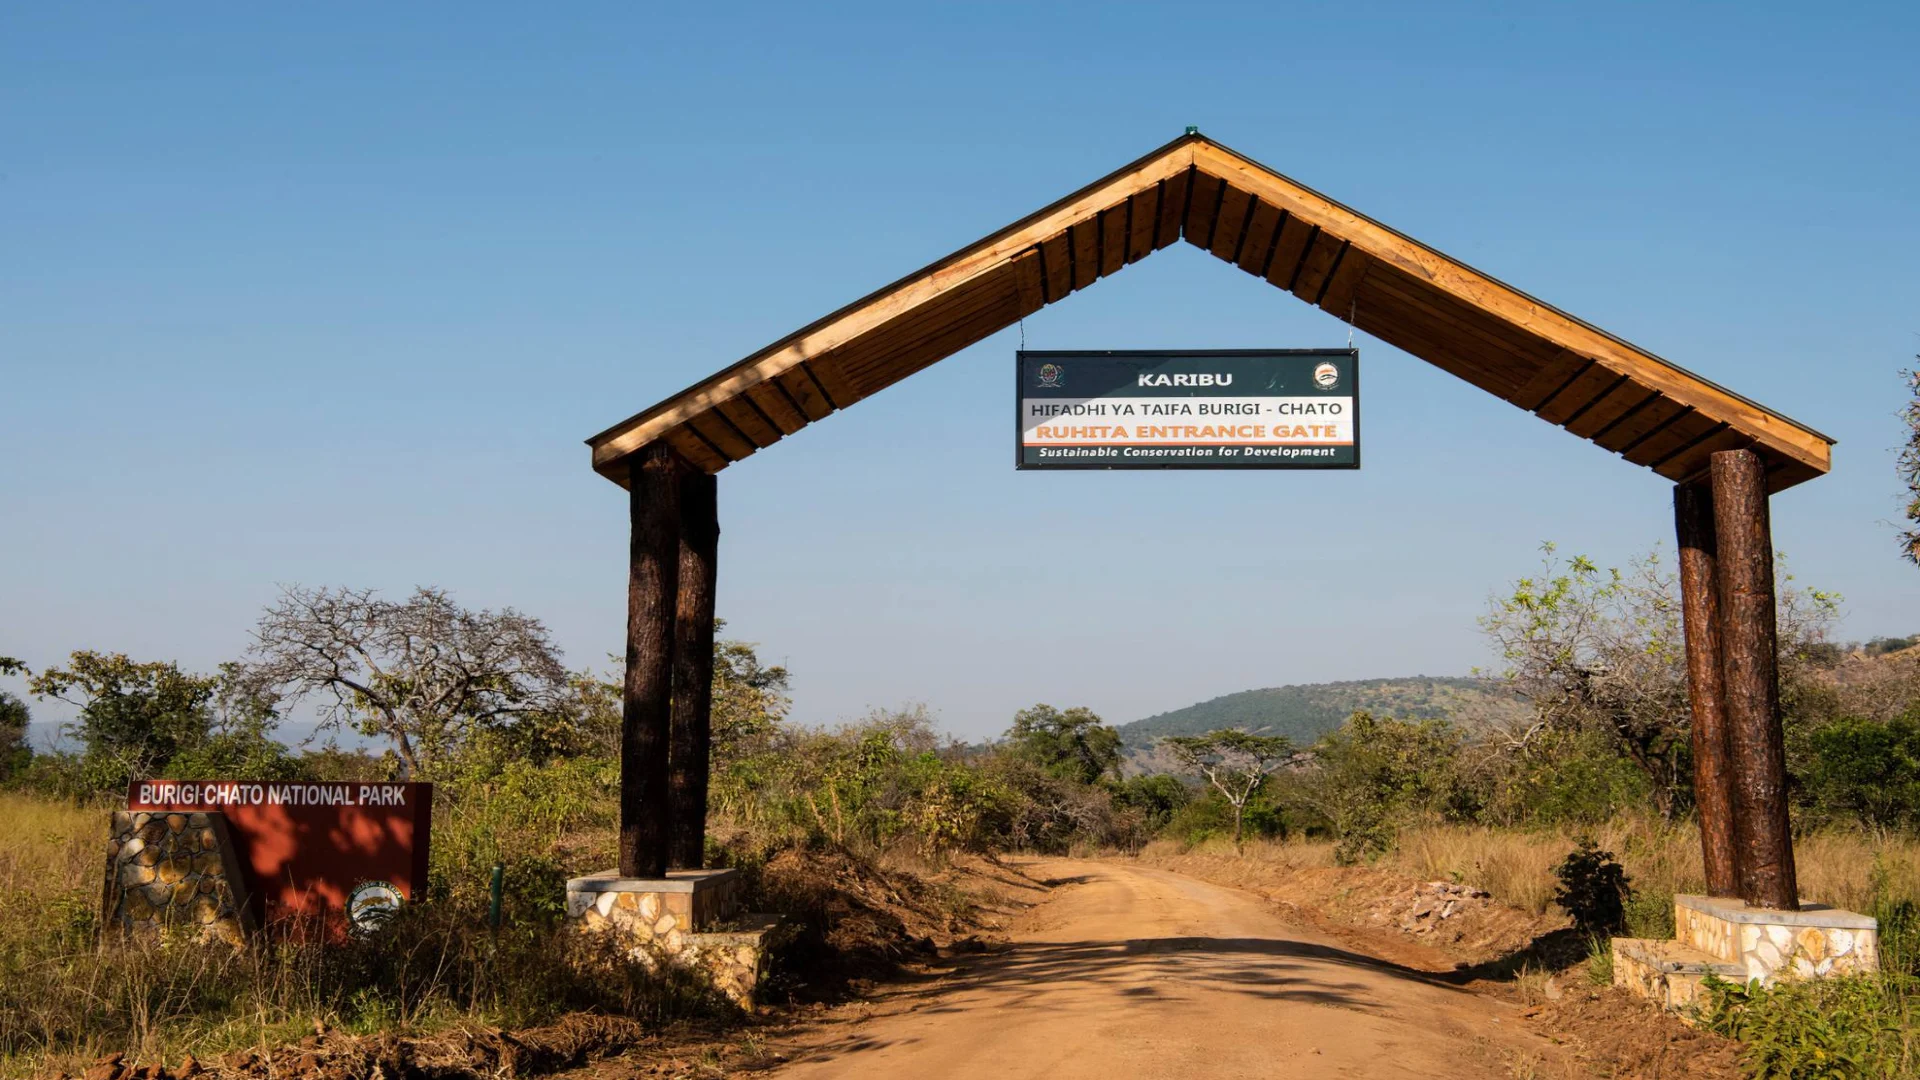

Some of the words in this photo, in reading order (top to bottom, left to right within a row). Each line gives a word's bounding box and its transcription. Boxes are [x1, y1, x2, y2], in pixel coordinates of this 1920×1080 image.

[1138, 374, 1232, 387] KARIBU
[1032, 404, 1106, 416] HIFADHI
[1112, 404, 1135, 416] YA
[1141, 403, 1192, 416] TAIFA
[1199, 403, 1260, 415] BURIGI
[1278, 403, 1342, 415] CHATO
[1036, 426, 1129, 439] RUHITA
[1136, 425, 1265, 438] ENTRANCE
[1272, 425, 1337, 438] GATE
[1039, 447, 1118, 457] Sustainable
[1123, 447, 1213, 457] Conservation
[1218, 447, 1239, 457] for
[1244, 447, 1335, 458] Development
[139, 784, 263, 805] BURIGI-CHATO
[268, 785, 354, 805] NATIONAL
[359, 786, 406, 806] PARK
